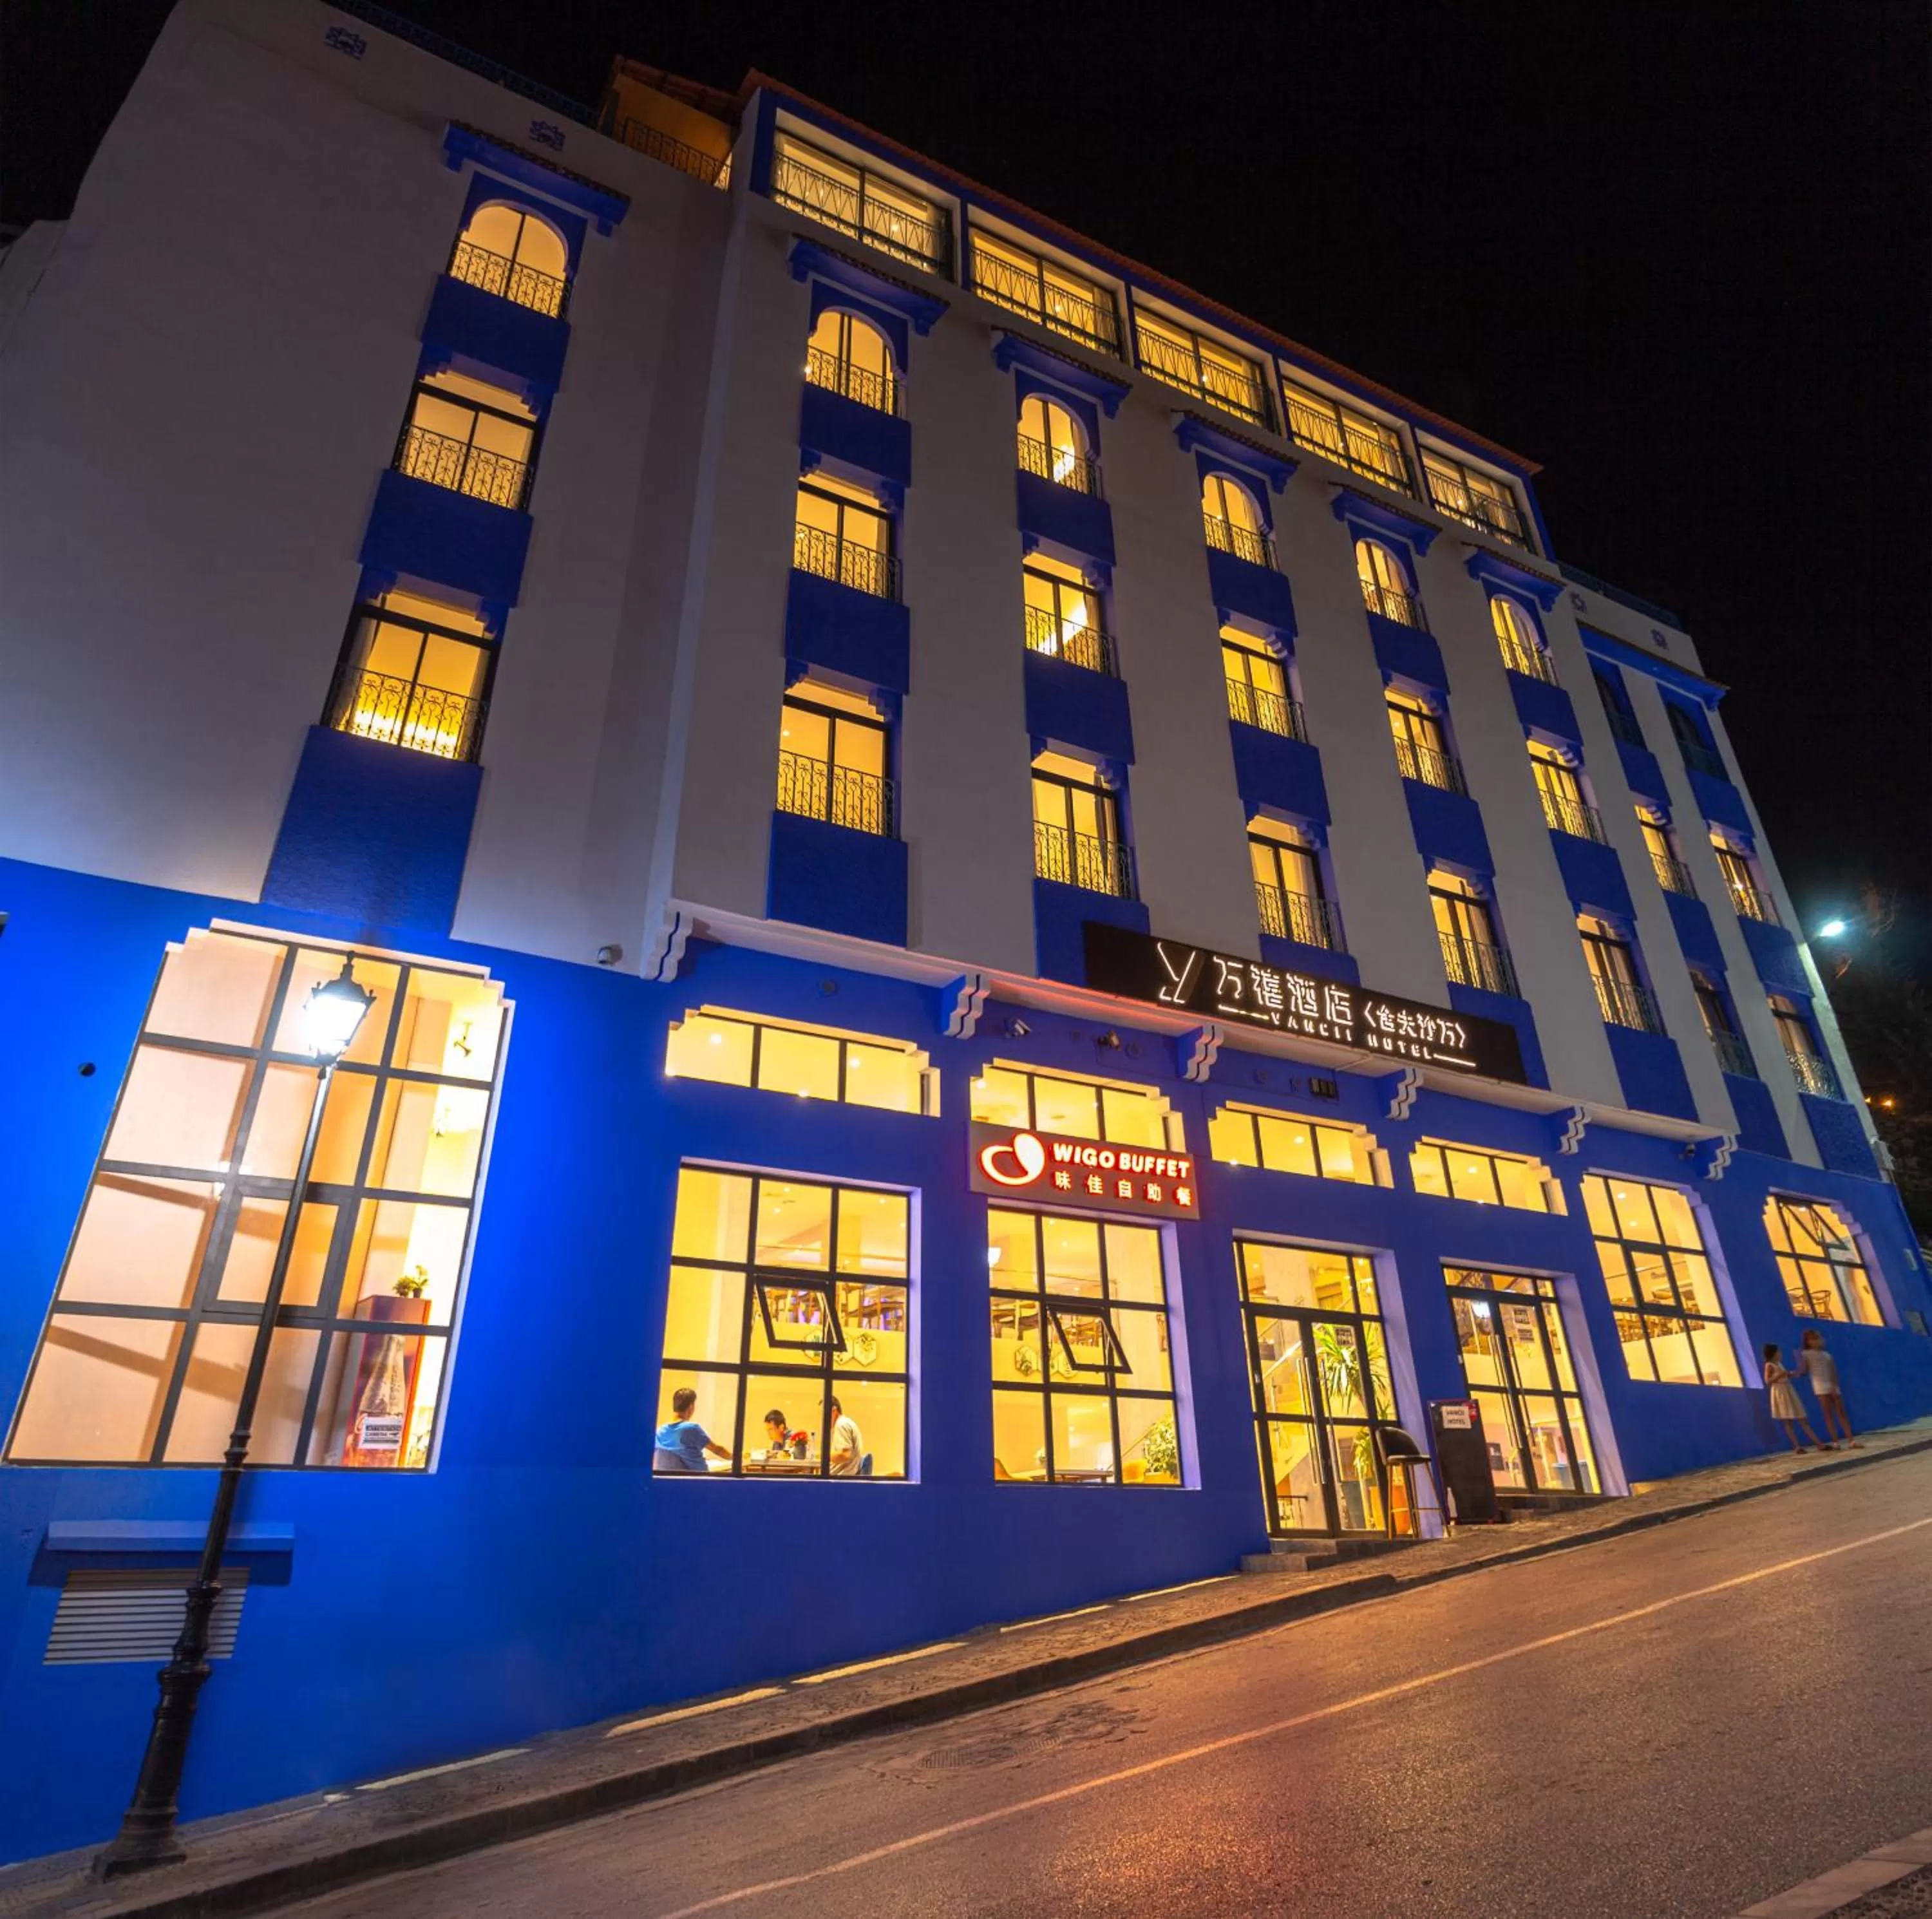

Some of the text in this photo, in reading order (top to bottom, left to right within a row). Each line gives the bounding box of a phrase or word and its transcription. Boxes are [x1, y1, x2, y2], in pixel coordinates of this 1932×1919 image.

[1367, 1034, 1433, 1061] HOTEL
[1052, 1142, 1190, 1178] WIGO BUFFET
[1054, 1171, 1191, 1207] 味佳自助餐
